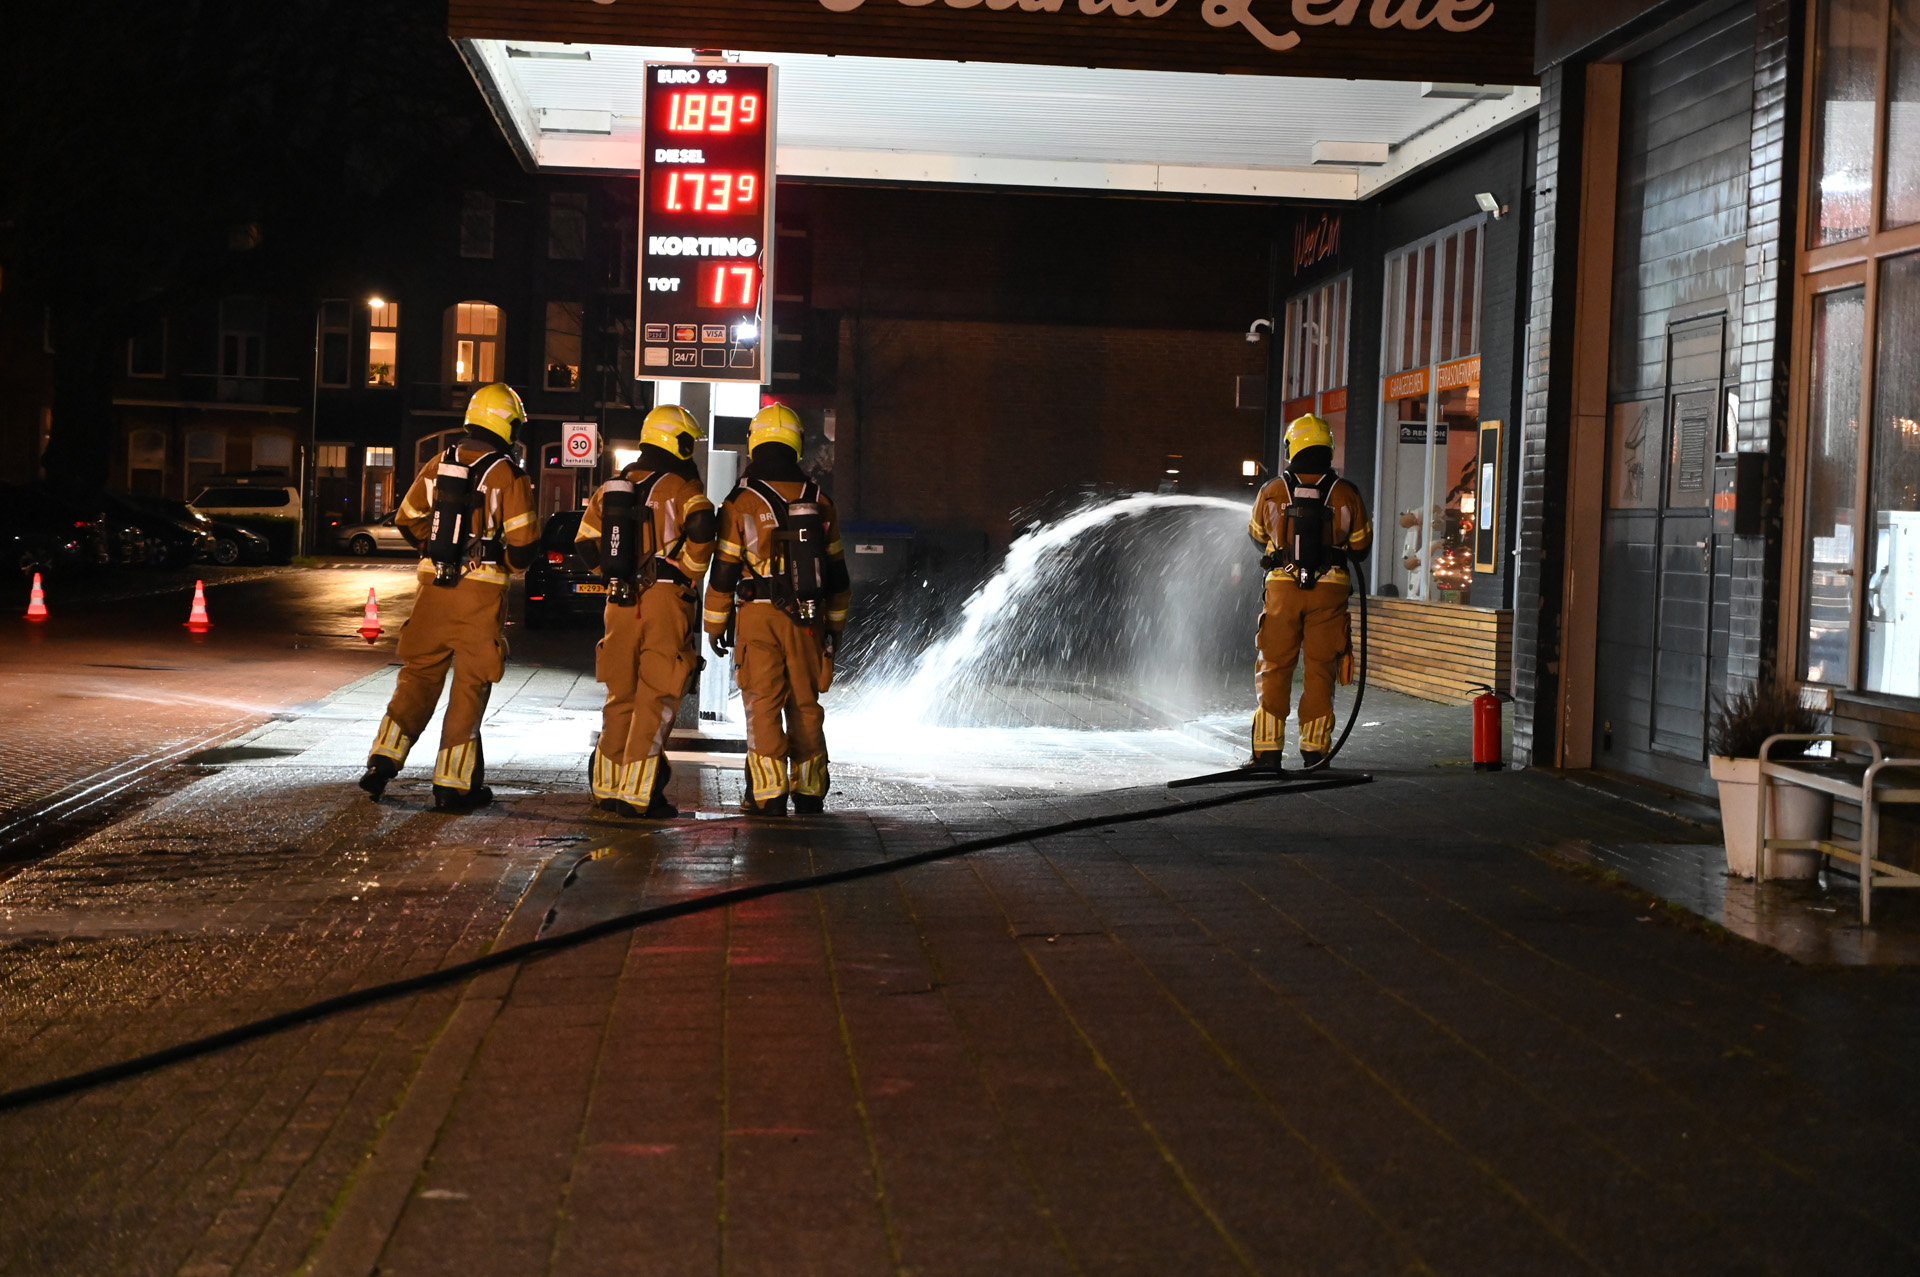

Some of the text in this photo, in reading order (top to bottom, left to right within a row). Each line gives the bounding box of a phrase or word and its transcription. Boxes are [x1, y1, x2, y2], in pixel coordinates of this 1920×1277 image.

[657, 69, 728, 84] EURO 95
[655, 149, 705, 163] DIESEL
[649, 236, 757, 257] KORTING
[647, 267, 753, 303] TOT 17
[706, 330, 723, 338] VISA
[674, 352, 695, 362] 24/7
[1412, 429, 1446, 437] RENON
[572, 440, 587, 450] 30
[431, 511, 440, 540] BMWB
[610, 526, 620, 556] BMWB
